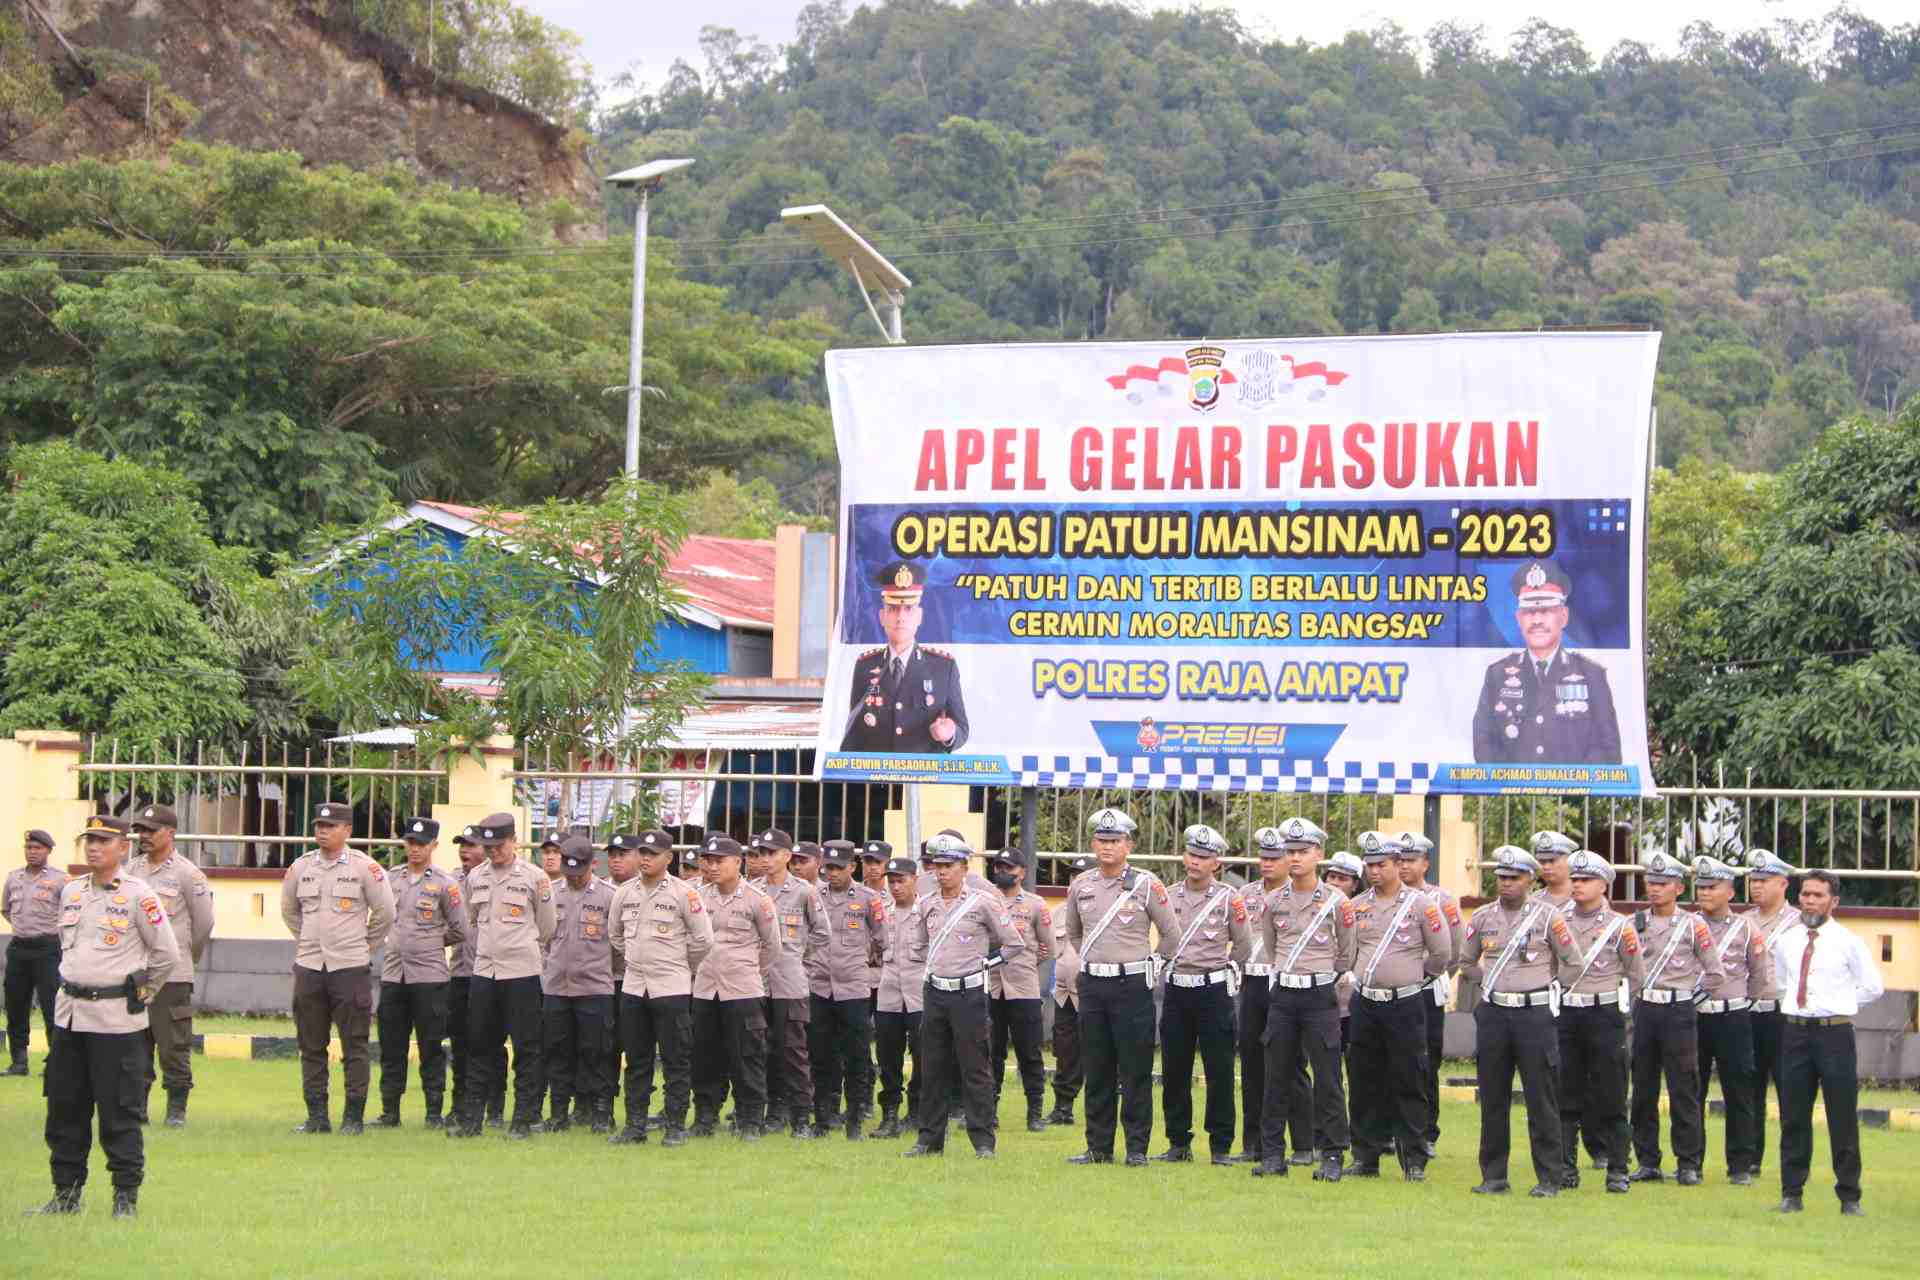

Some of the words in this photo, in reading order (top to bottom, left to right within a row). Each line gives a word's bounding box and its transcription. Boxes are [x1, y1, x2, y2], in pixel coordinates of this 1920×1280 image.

[914, 428, 1046, 491] APEL
[1069, 426, 1242, 491] GELAR
[1265, 420, 1540, 489] PASUKAN
[896, 516, 1051, 554] OPERASI
[1064, 516, 1187, 554] PATUH
[1200, 515, 1421, 554] MANSINAM
[1433, 533, 1449, 543] -
[1459, 513, 1552, 553] 2023
[1077, 575, 1142, 600] DAN
[1151, 575, 1242, 600] TERTIB
[1250, 575, 1379, 601] BERLALU
[1388, 575, 1488, 602] LINTAS
[1009, 611, 1120, 637] CERMIN
[1128, 611, 1291, 639] MORALITAS
[1035, 659, 1169, 696] POLRES
[1179, 662, 1269, 697] RAJA
[1279, 664, 1406, 698] AMPAT
[1161, 724, 1287, 746] PRESISI
[851, 759, 881, 770] EDWIN
[1491, 768, 1531, 781] ACHMAD
[506, 885, 527, 894] POLRI
[105, 906, 129, 917] POLRI
[582, 903, 604, 912] POLRI
[655, 902, 676, 912] POLRI
